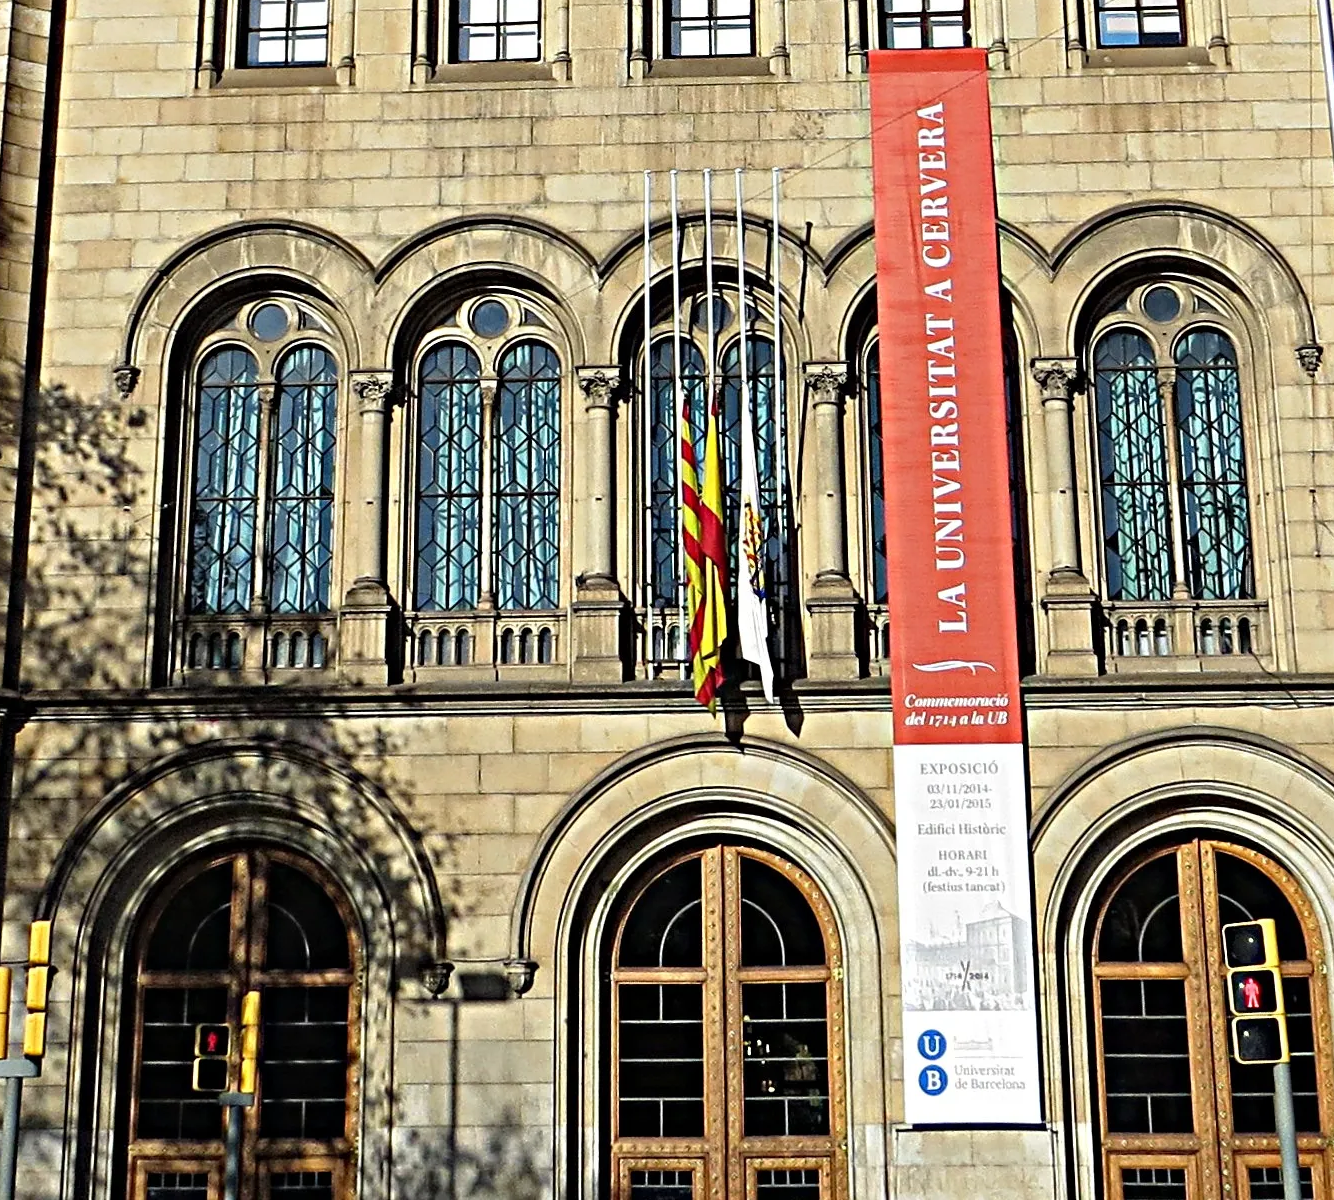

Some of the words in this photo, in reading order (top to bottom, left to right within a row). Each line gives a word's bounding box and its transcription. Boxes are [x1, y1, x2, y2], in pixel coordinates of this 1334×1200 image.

[918, 102, 950, 268] CERVERA
[924, 278, 953, 303] A
[925, 313, 965, 571] UNIVERSITAT
[938, 582, 968, 634] LA
[904, 693, 1009, 708] Commemoració
[904, 711, 927, 726] del
[928, 714, 957, 727] 1714
[959, 715, 969, 725] a
[971, 710, 985, 725] la
[987, 711, 1008, 725] UB
[920, 760, 999, 775] EXPOSICIÓ
[930, 798, 992, 810] 23/01/2015
[917, 823, 956, 835] Edifici
[958, 822, 1007, 835] Històric
[938, 849, 987, 861] HORARI
[965, 866, 989, 877] 9-21
[991, 865, 999, 877] h
[922, 880, 964, 894] (festius
[965, 880, 1006, 894] tancat)
[923, 1037, 941, 1057] U
[954, 1065, 1015, 1076] Universitat
[926, 1069, 942, 1091] B
[954, 1077, 968, 1089] de
[970, 1078, 1026, 1090] Barcelona
